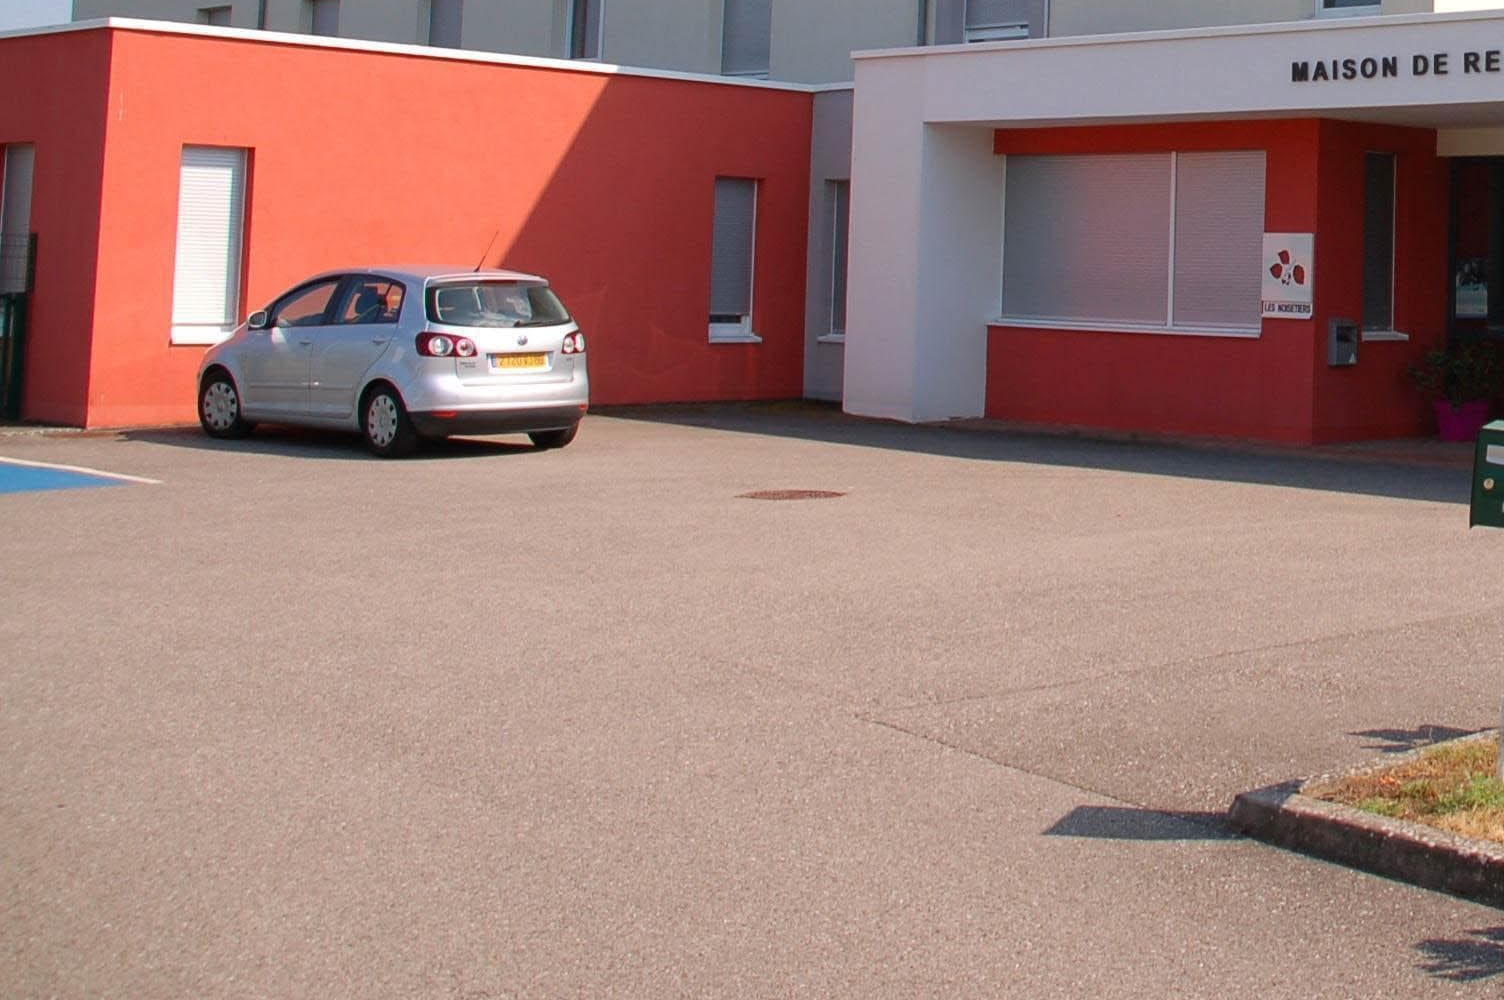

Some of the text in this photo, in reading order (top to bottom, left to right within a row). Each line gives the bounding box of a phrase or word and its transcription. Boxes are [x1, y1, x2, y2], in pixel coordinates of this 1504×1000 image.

[1291, 56, 1398, 82] MAISON
[1412, 53, 1449, 76] DE
[1264, 303, 1311, 314] LES NOISETIERS
